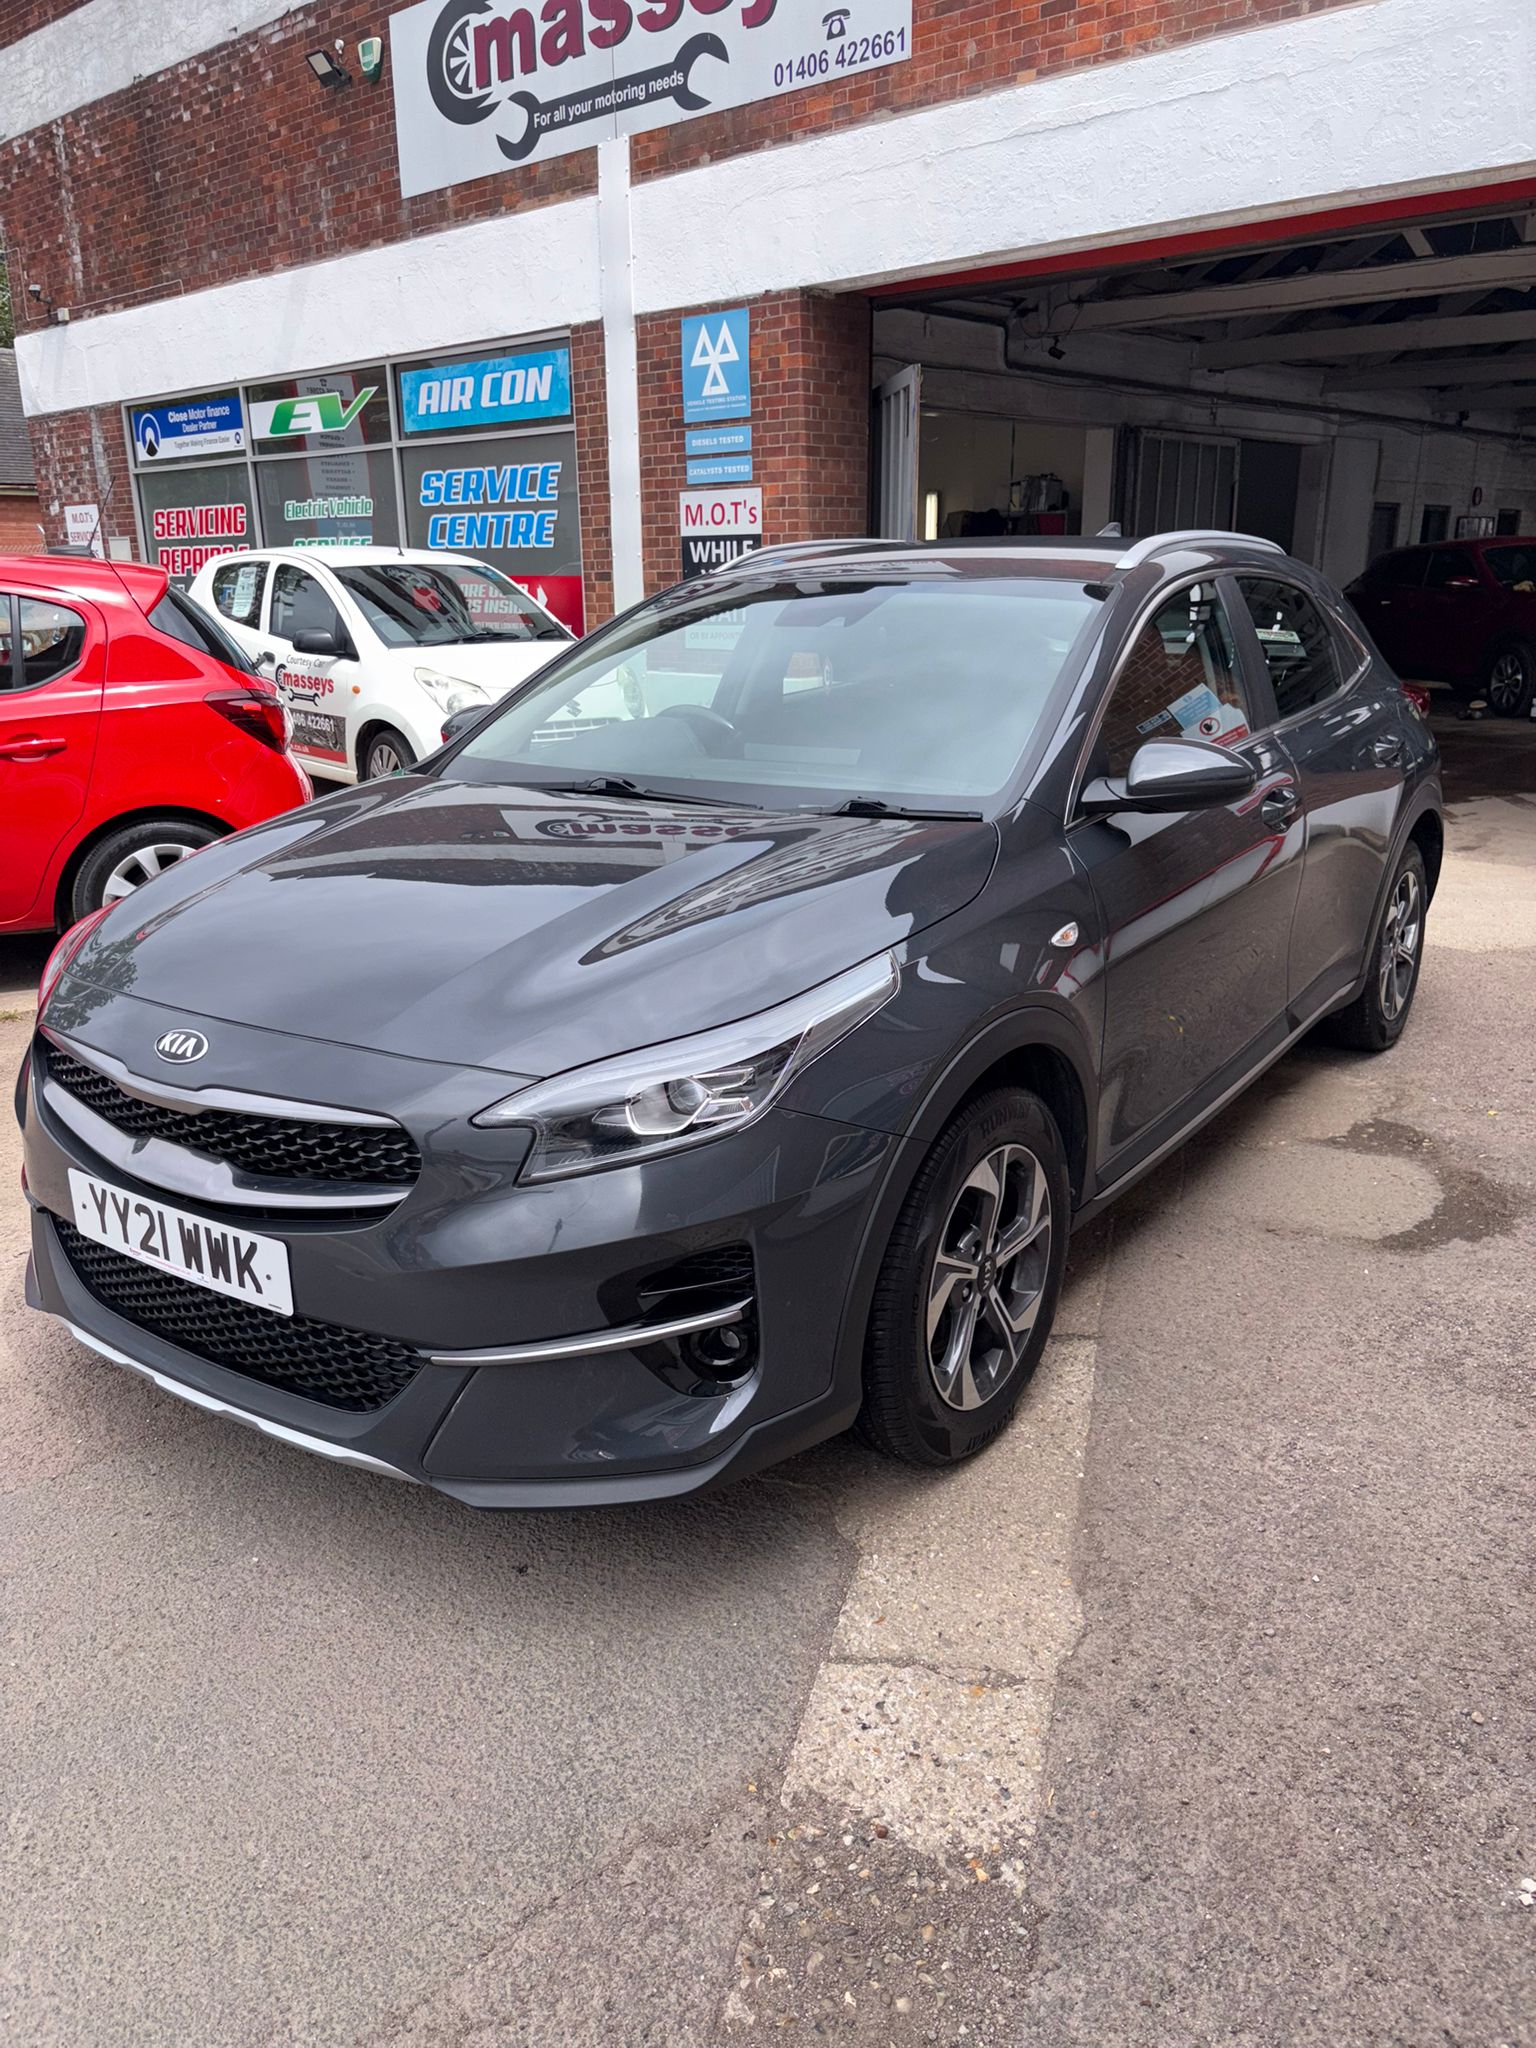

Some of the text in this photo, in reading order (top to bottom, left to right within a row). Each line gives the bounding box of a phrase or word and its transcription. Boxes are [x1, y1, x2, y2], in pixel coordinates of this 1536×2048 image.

[774, 26, 906, 87] 01406 422661
[533, 70, 684, 128] For all your motoring needs
[418, 365, 553, 415] AIR CON
[168, 411, 188, 423] Close
[188, 408, 207, 420] Motor
[268, 387, 379, 434] EV
[182, 421, 217, 433] Dealer Partner
[691, 435, 744, 447] DIESELS TESTED
[688, 464, 750, 476] CATALYSTS TESTED
[420, 462, 562, 506] SERVICE
[154, 503, 247, 540] SERVICING
[284, 495, 373, 521] Electric Vehicle
[685, 499, 757, 526] M.O.T's
[428, 510, 558, 549] CENTRE
[286, 654, 328, 670] Courtesy Car
[283, 671, 334, 697] masseys
[307, 715, 334, 732] 422661
[158, 1032, 198, 1058] KIA
[89, 1182, 170, 1261] YY21
[177, 1217, 263, 1295] WWK
[983, 1261, 991, 1290] KIA
